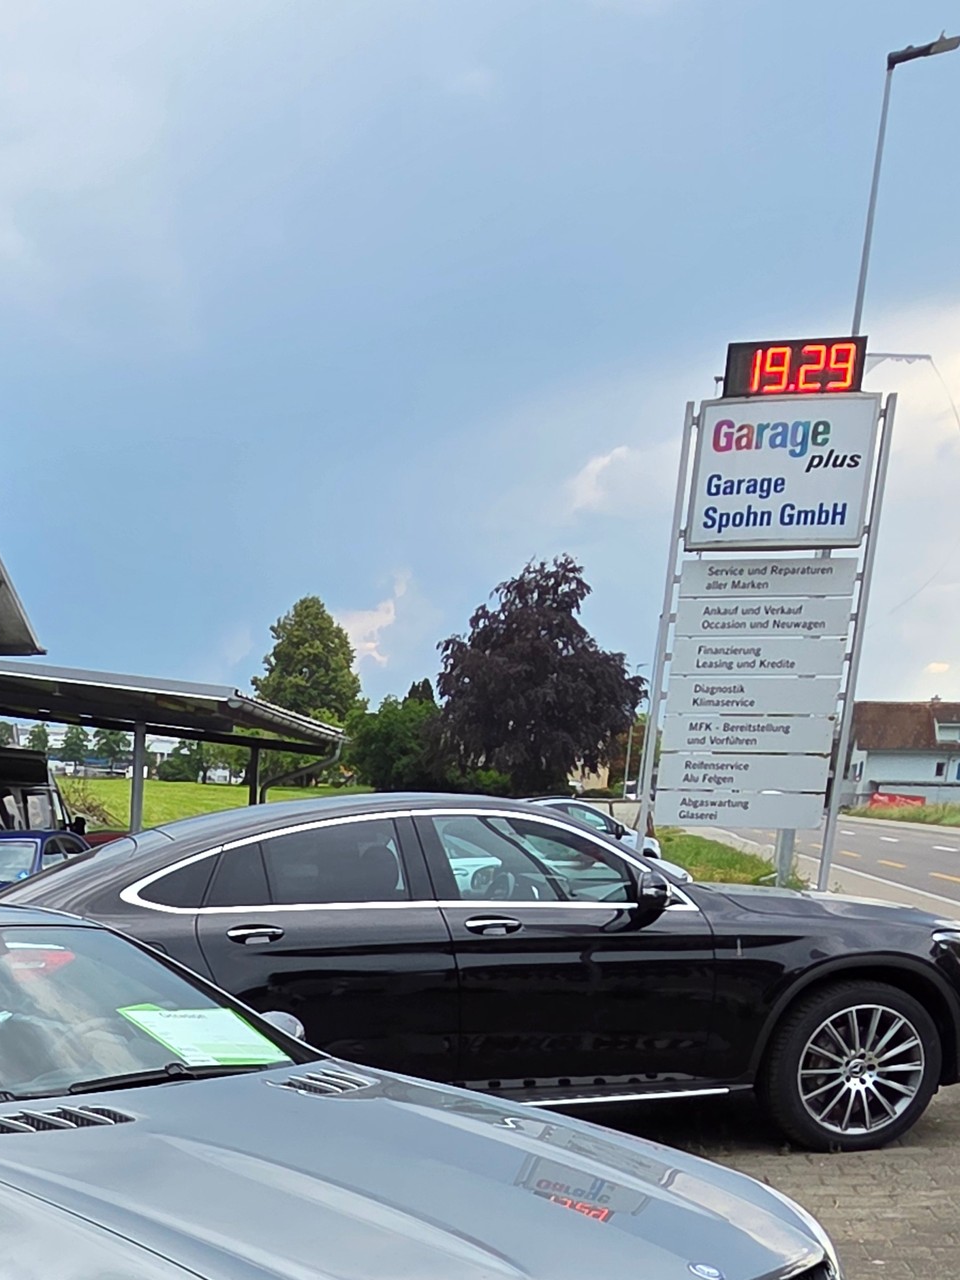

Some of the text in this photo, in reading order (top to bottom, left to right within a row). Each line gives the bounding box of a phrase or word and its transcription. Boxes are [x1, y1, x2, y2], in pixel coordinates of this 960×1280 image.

[712, 418, 831, 458] Garage
[805, 449, 862, 473] plus
[706, 474, 786, 499] Garage
[702, 502, 848, 533] Spohn GmbH
[708, 564, 834, 577] Service und Reparaturen
[705, 580, 769, 590] aller Marken
[702, 605, 803, 616] Ankauf und Verkauf
[701, 620, 826, 631] Occasion und Neuwagen
[697, 645, 762, 657] Finanzierung
[695, 659, 796, 671] Leasing und Kredite
[693, 684, 745, 696] Diagnostik
[692, 698, 756, 708] Klimaservice
[688, 722, 712, 732] MFK
[722, 722, 791, 735] Bereitstellung
[687, 735, 757, 746] und Vorführen
[684, 760, 750, 771] Reifenservice
[682, 773, 734, 785] Alu Felgen
[680, 797, 750, 810] Abgaswartung
[678, 810, 718, 820] Glaserei
